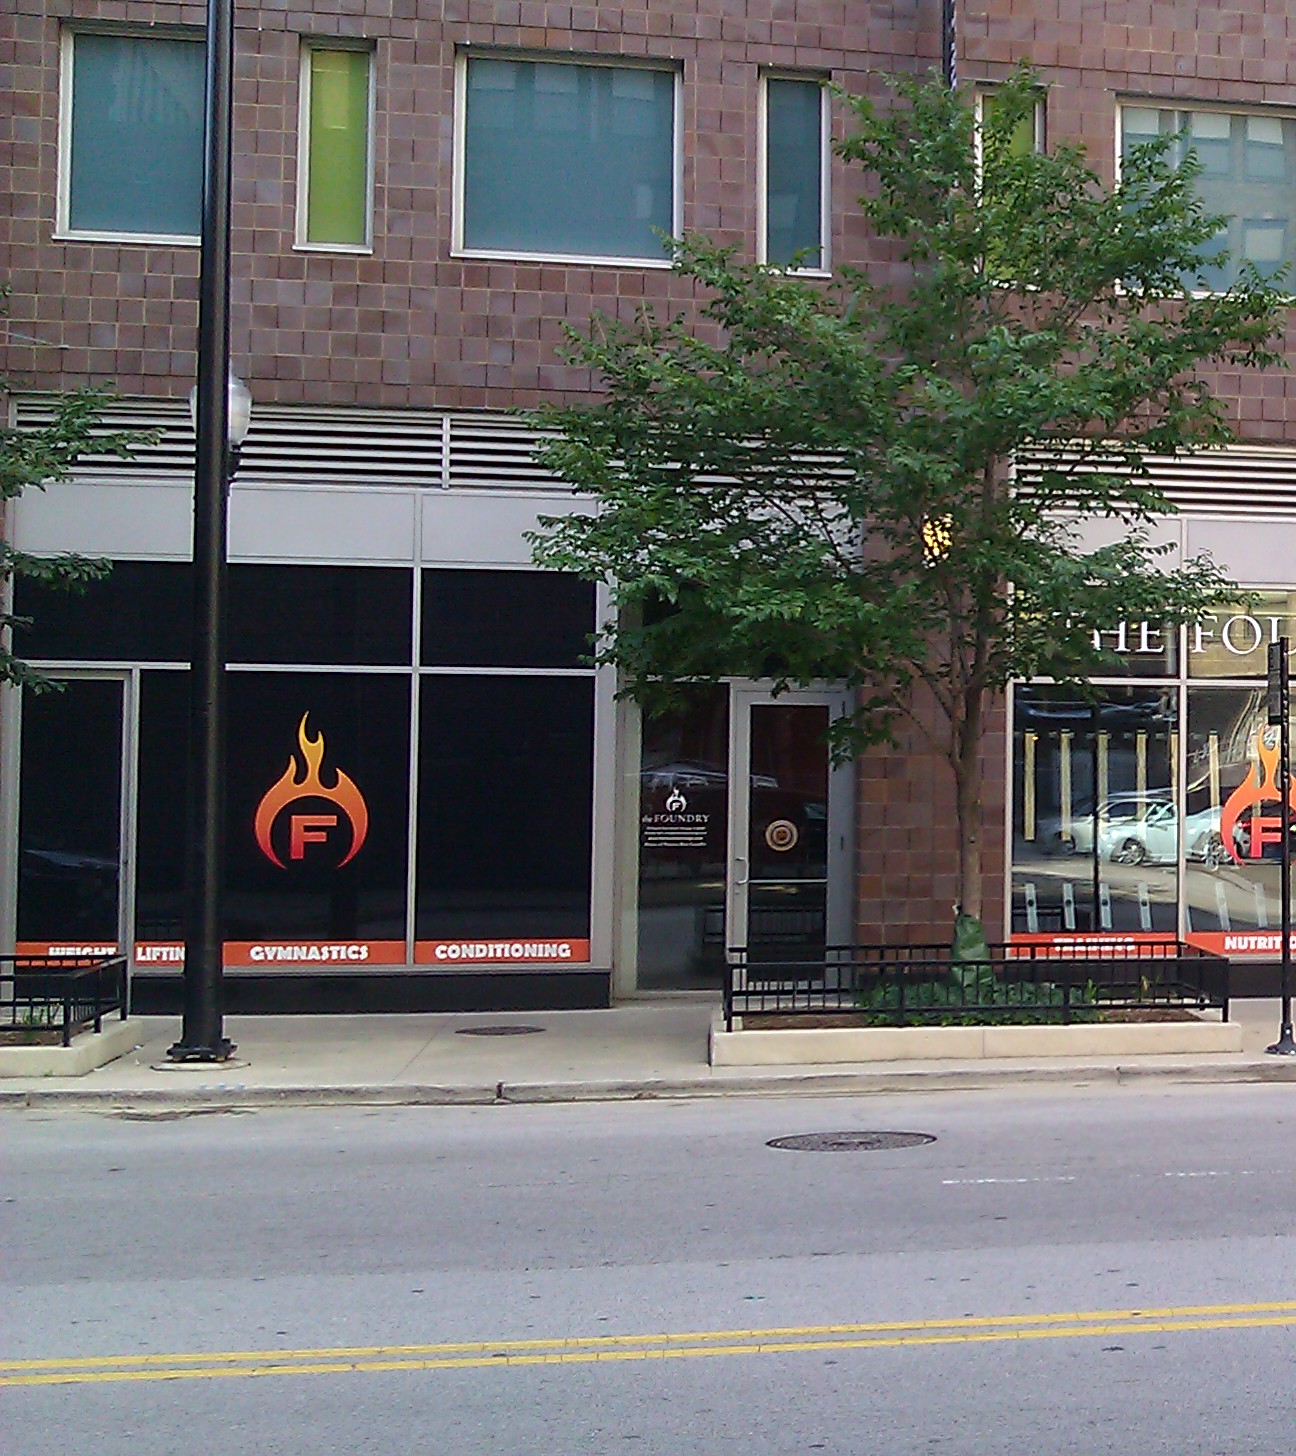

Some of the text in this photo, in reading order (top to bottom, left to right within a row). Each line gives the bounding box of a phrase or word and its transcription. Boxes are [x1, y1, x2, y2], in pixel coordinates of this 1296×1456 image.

[1091, 619, 1166, 652] HE
[653, 814, 710, 823] FOUNDRY
[290, 815, 338, 860] F
[250, 945, 369, 961] GYMNASTICS
[435, 943, 571, 960] CONDITIONING
